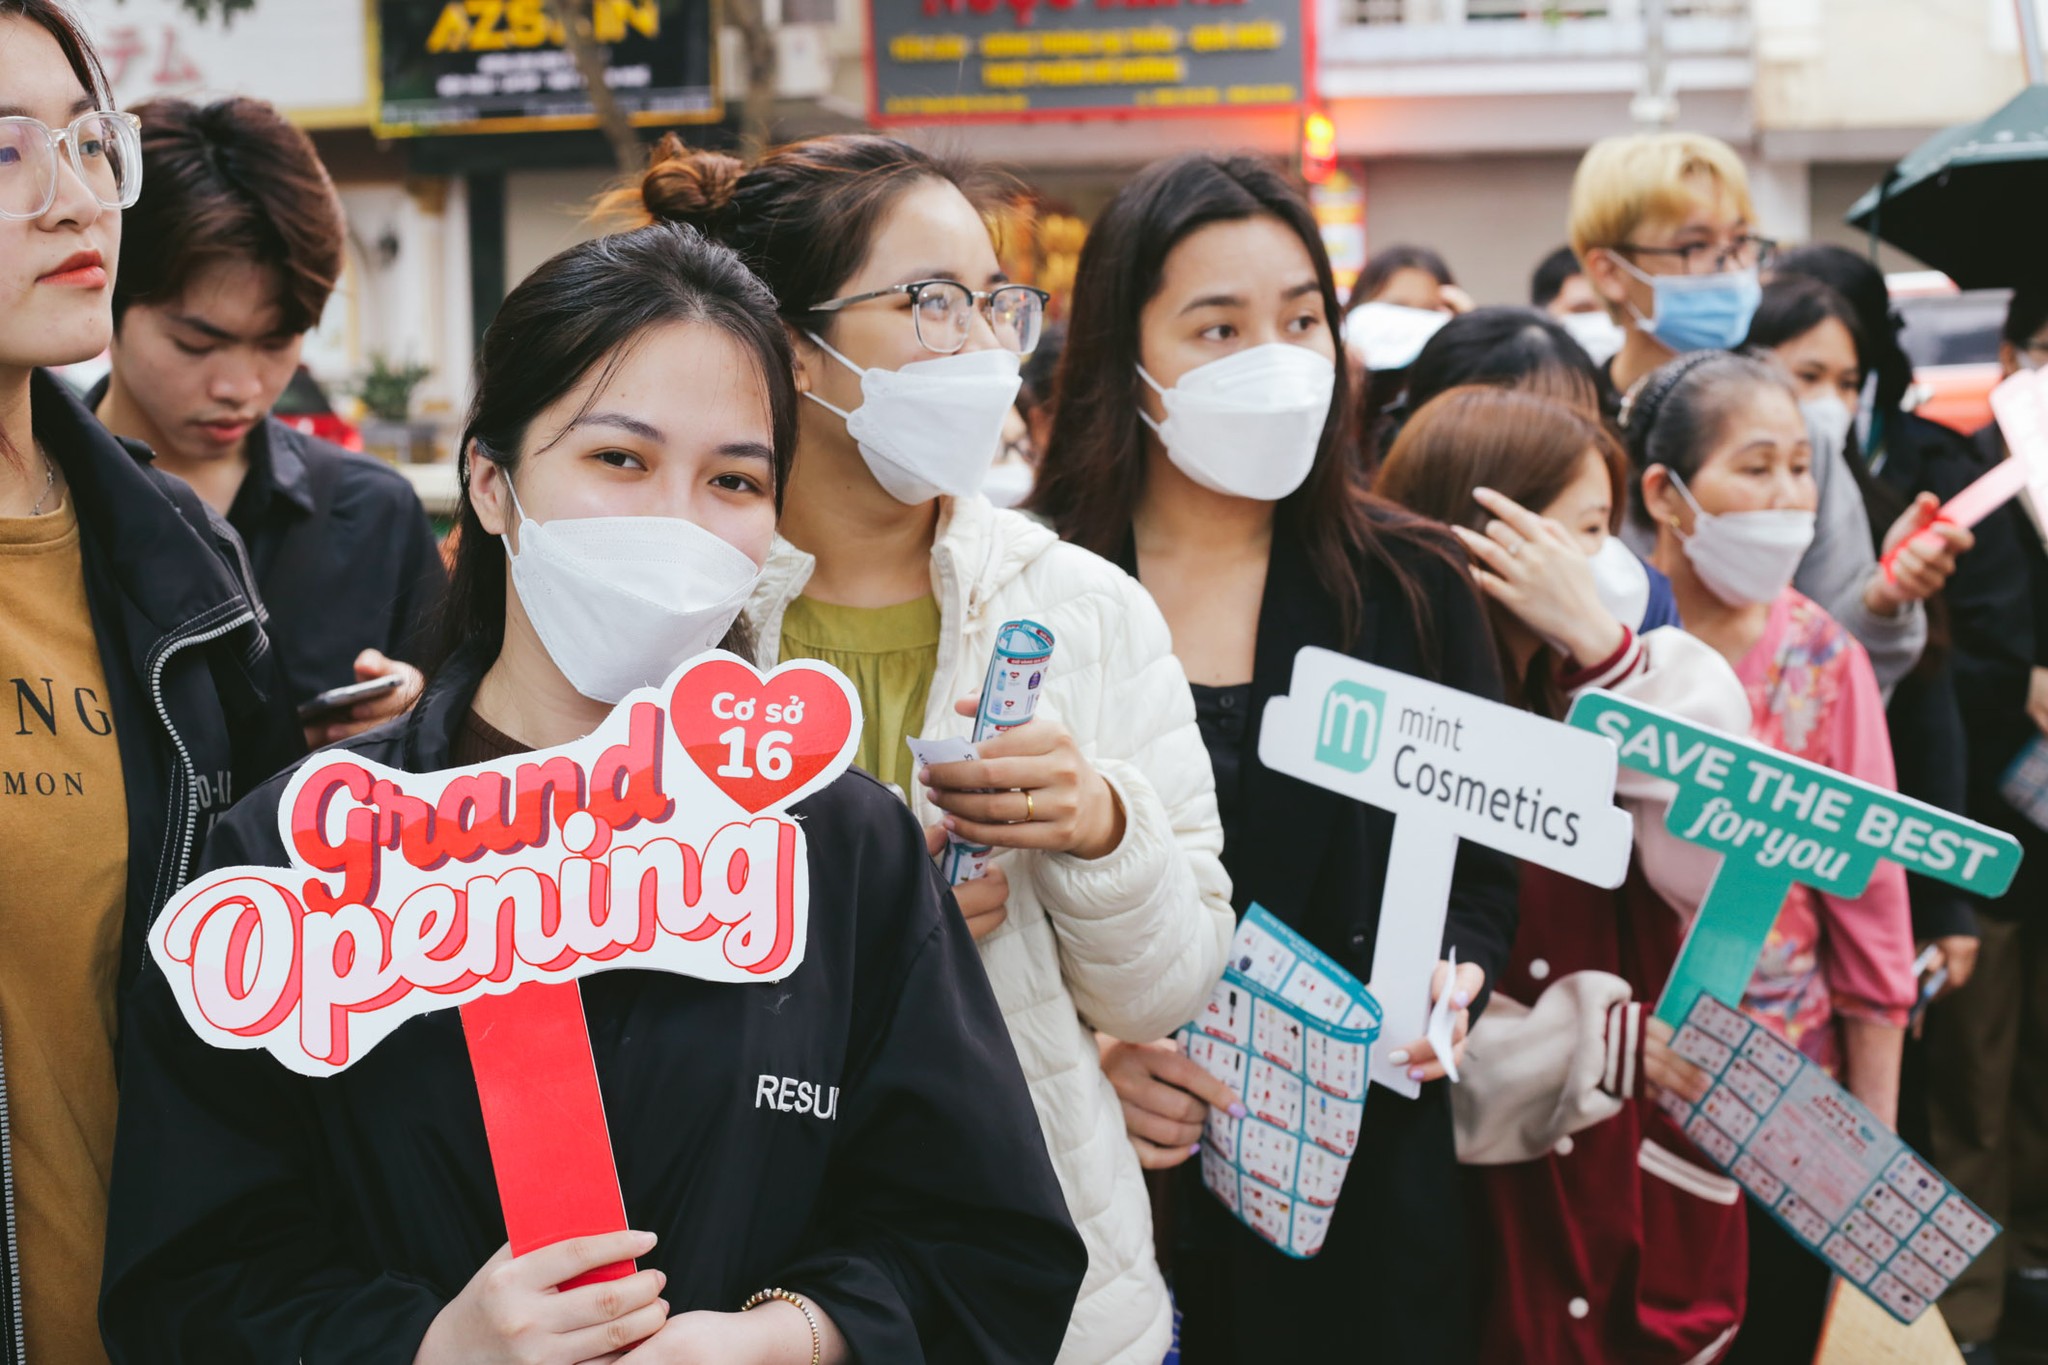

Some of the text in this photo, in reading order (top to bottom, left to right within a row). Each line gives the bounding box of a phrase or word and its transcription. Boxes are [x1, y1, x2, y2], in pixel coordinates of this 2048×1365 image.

[426, 0, 660, 53] AZSIN
[711, 692, 805, 725] Cơ sở
[1399, 707, 1464, 752] mint
[3, 771, 85, 796] MON
[717, 726, 794, 781] 16
[291, 702, 675, 908] Grand
[1393, 744, 1581, 847] Cosmetics
[1596, 710, 1999, 882] SAVE THE BEST
[1684, 797, 1851, 882] for you
[164, 811, 797, 1066] Opening
